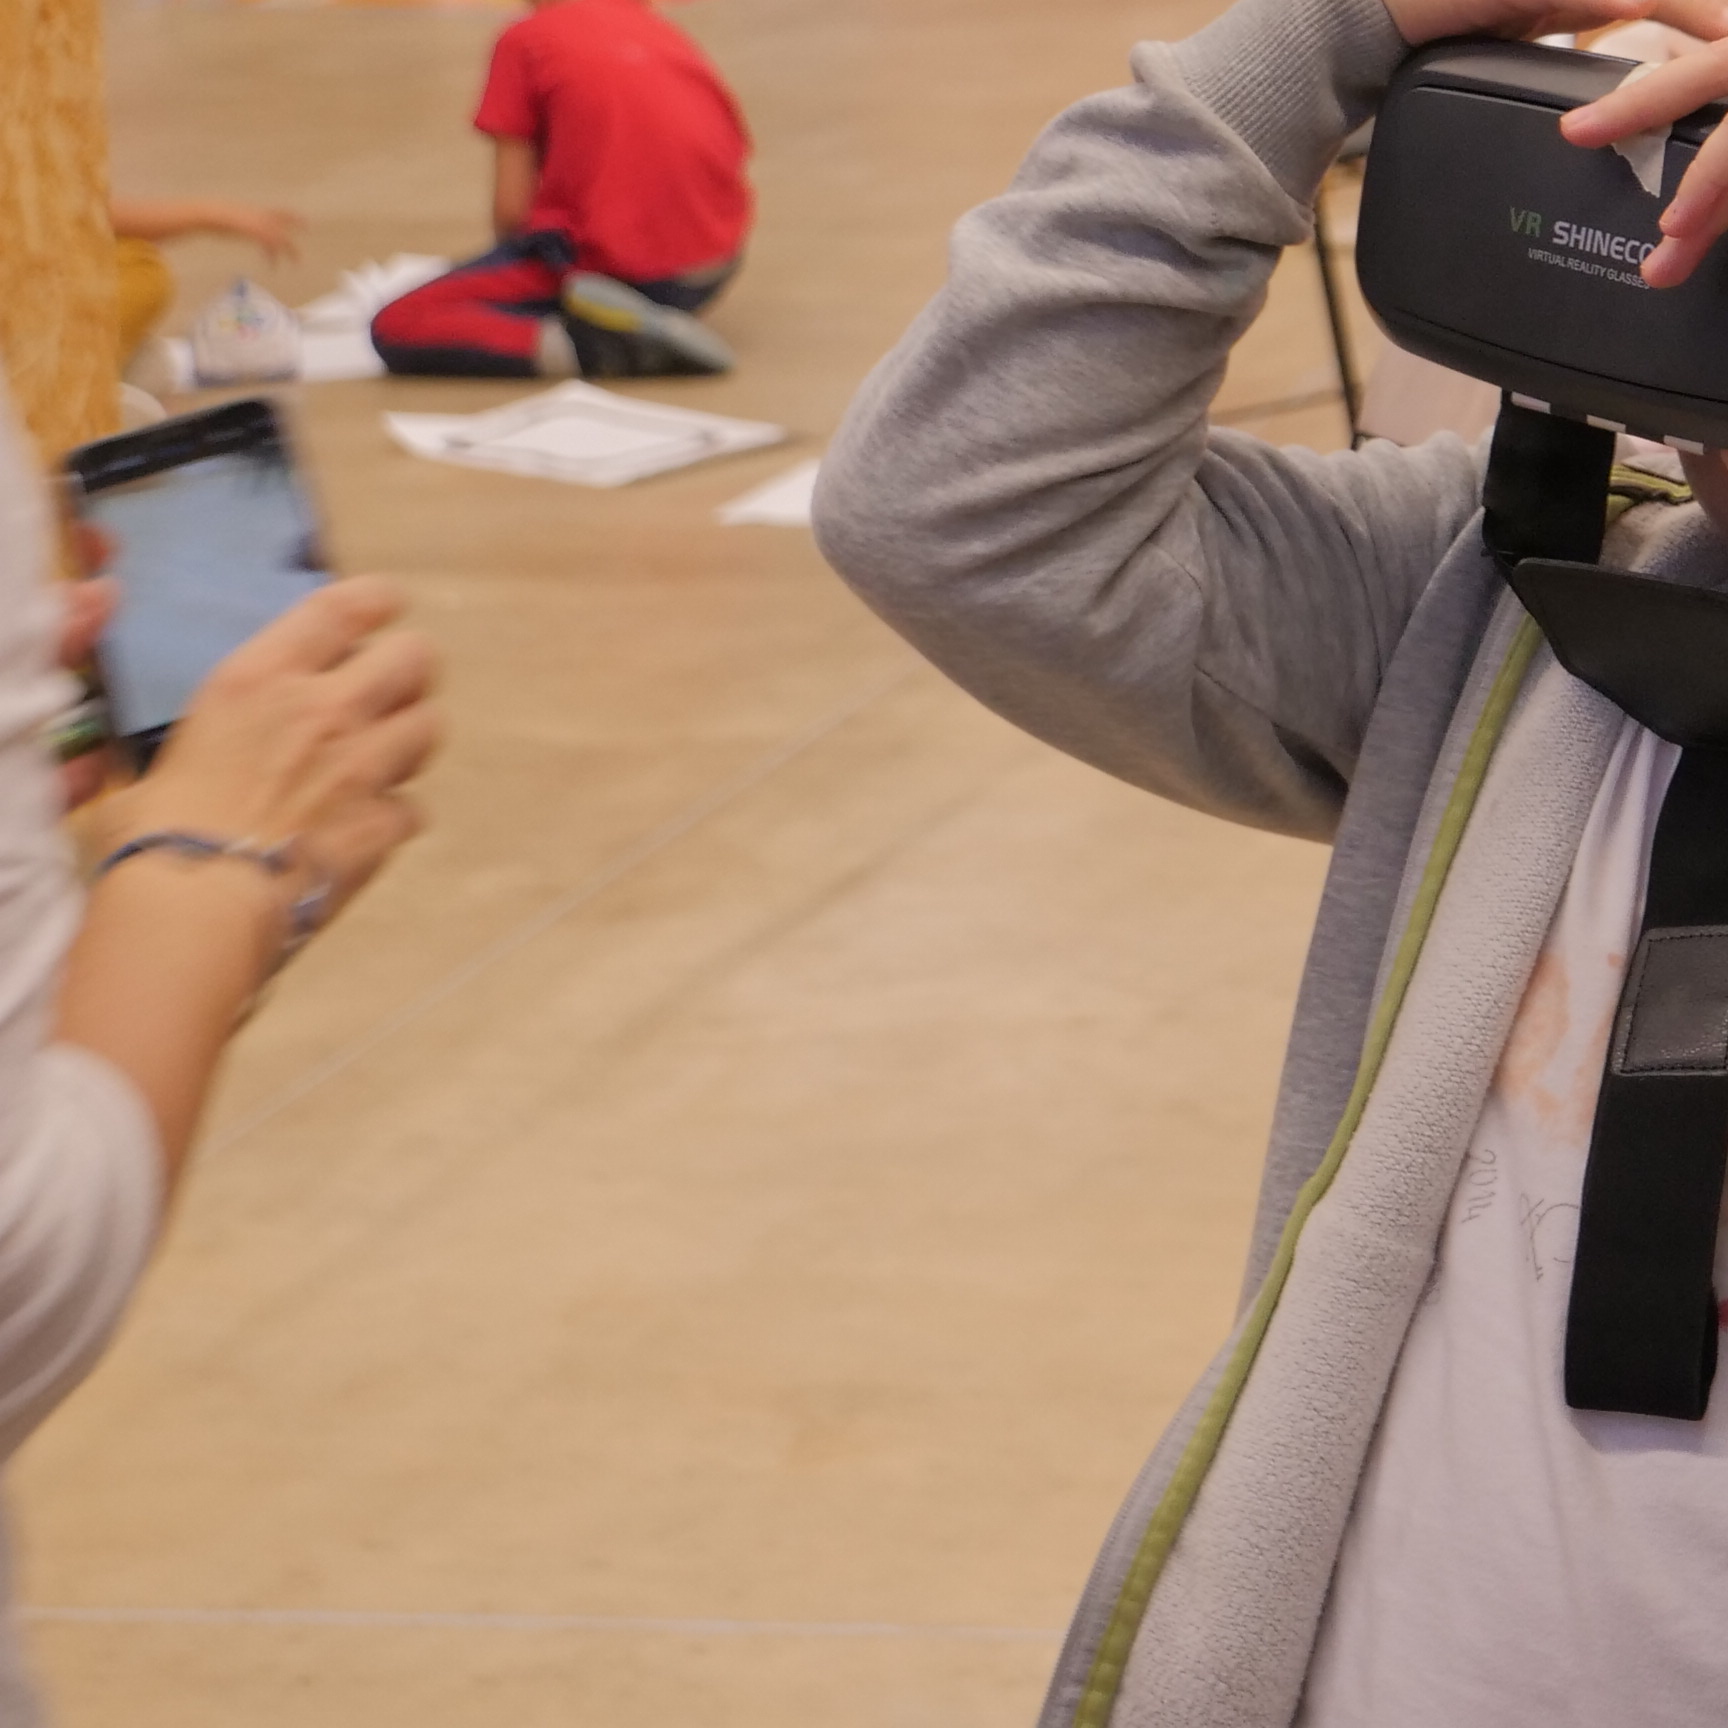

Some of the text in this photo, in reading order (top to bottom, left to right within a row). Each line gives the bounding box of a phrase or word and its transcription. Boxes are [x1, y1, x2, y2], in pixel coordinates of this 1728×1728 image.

[1510, 206, 1542, 238] VR
[1528, 247, 1567, 268] VIRTUAL
[1567, 257, 1606, 278] REALITY
